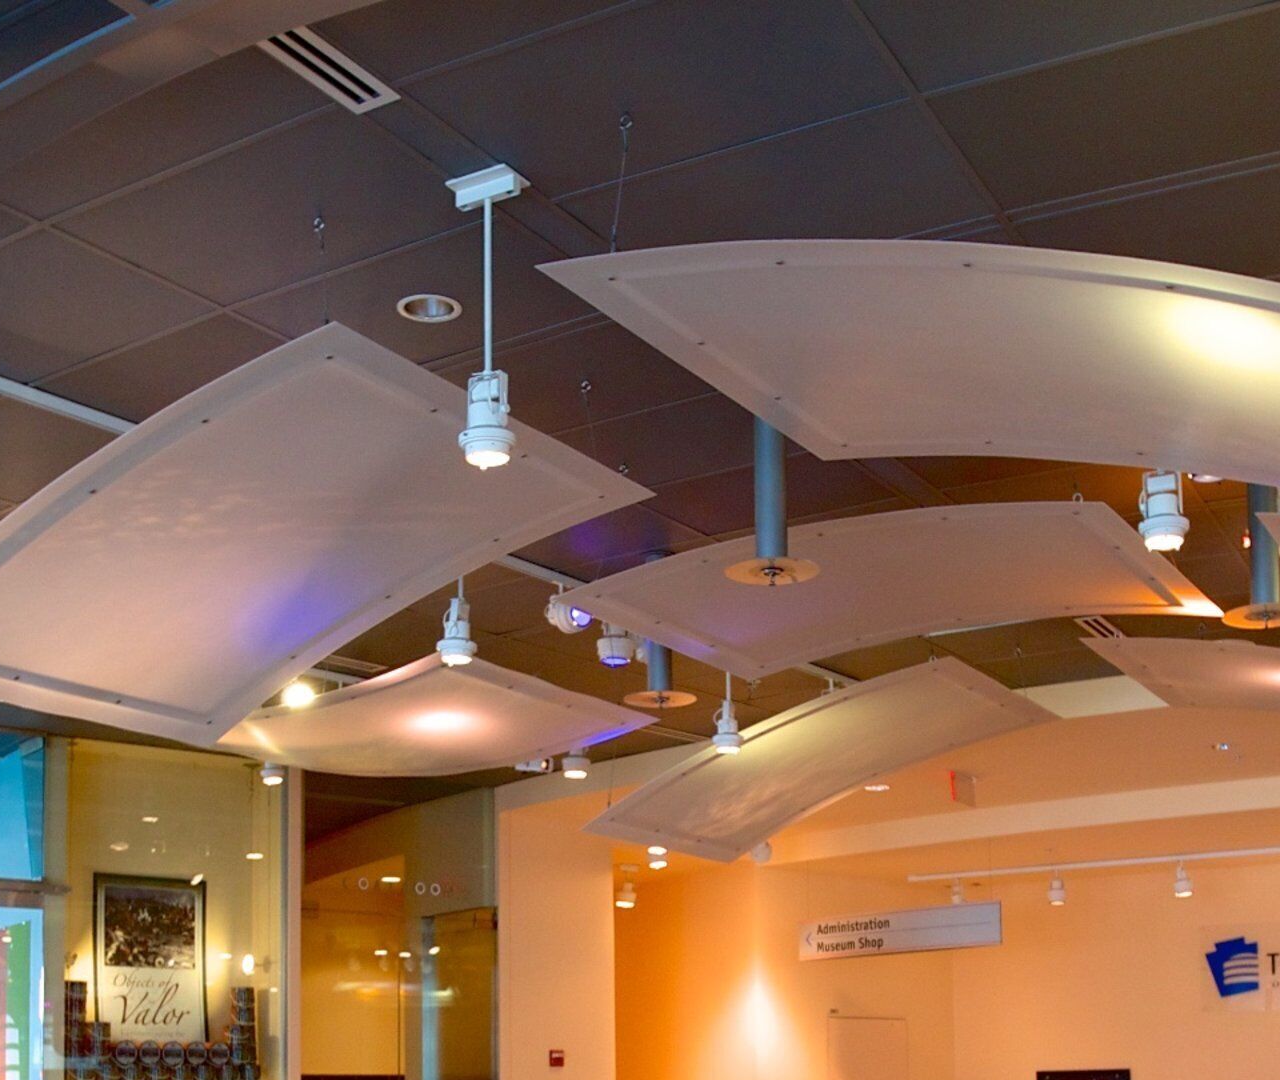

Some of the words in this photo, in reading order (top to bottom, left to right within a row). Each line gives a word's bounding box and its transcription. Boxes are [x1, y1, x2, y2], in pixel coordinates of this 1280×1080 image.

[817, 917, 891, 936] Administration
[817, 940, 856, 953] Museum
[858, 936, 884, 950] Shop
[113, 983, 191, 1026] Valor
